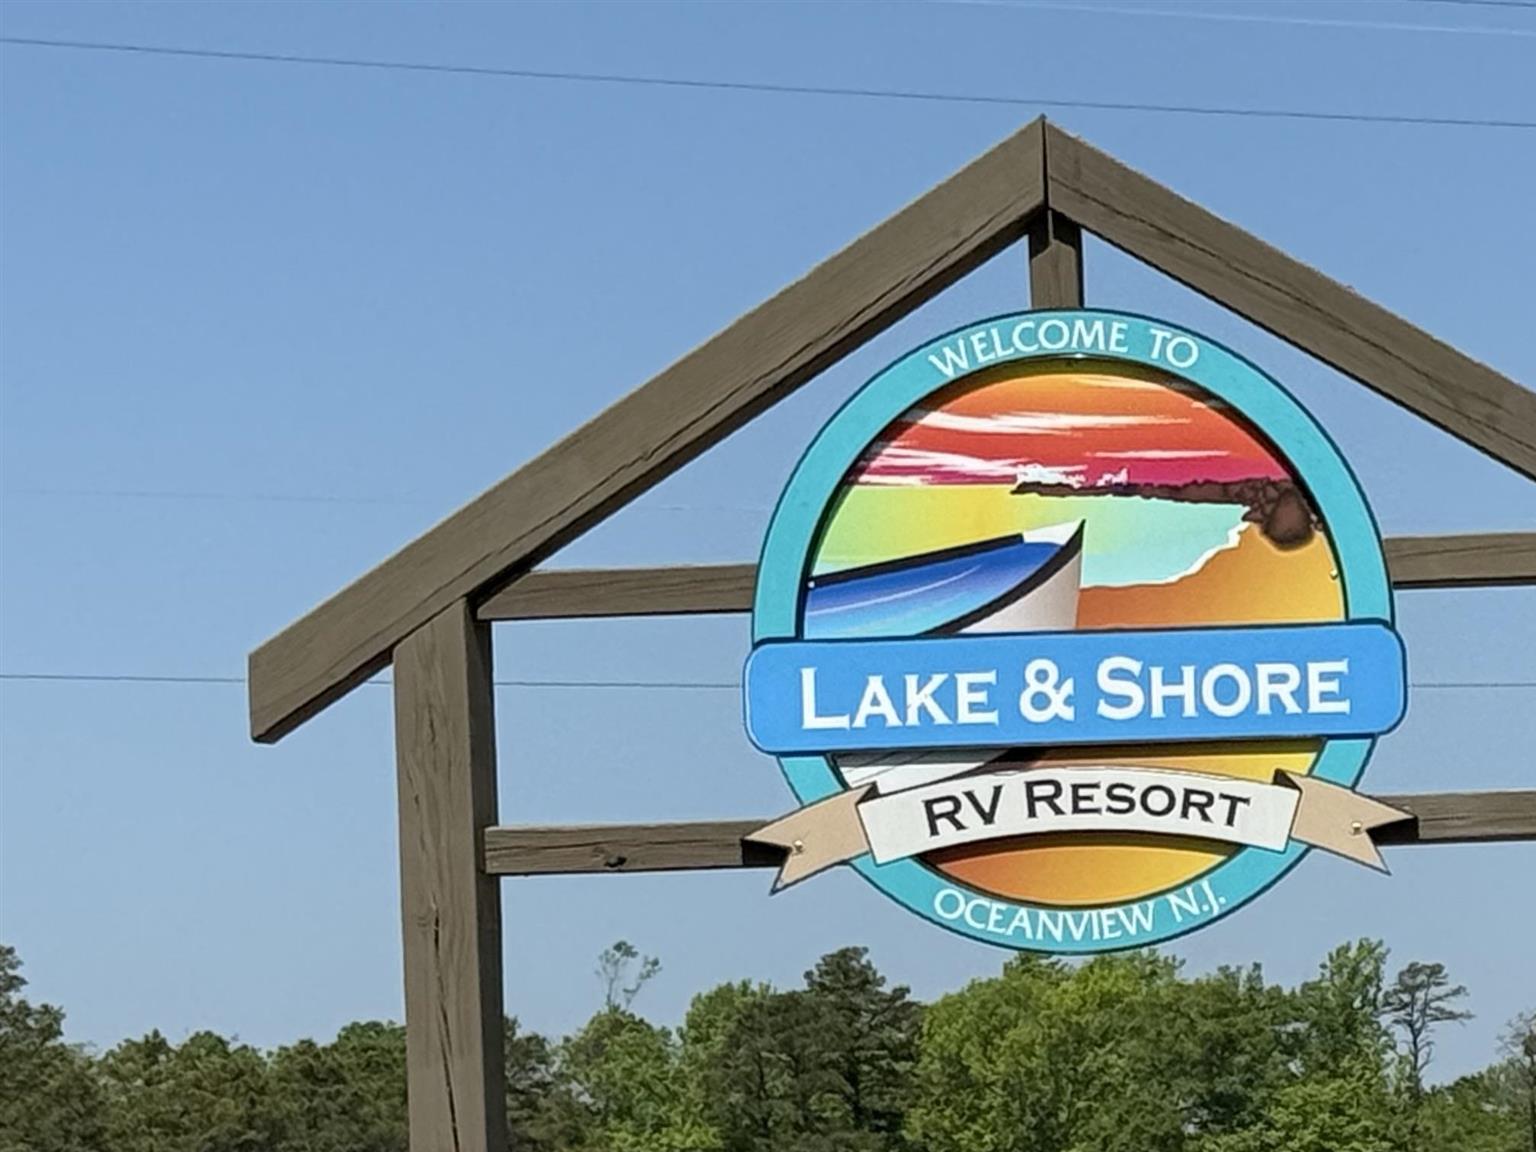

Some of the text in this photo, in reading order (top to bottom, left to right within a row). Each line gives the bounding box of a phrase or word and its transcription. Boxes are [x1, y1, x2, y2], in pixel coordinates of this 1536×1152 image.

[928, 320, 1199, 379] WELCOME TO
[800, 656, 1351, 731] LAKE & SHORE
[924, 779, 1252, 837] RV RESORT
[933, 882, 1227, 941] OCEANVIEW N.J.
